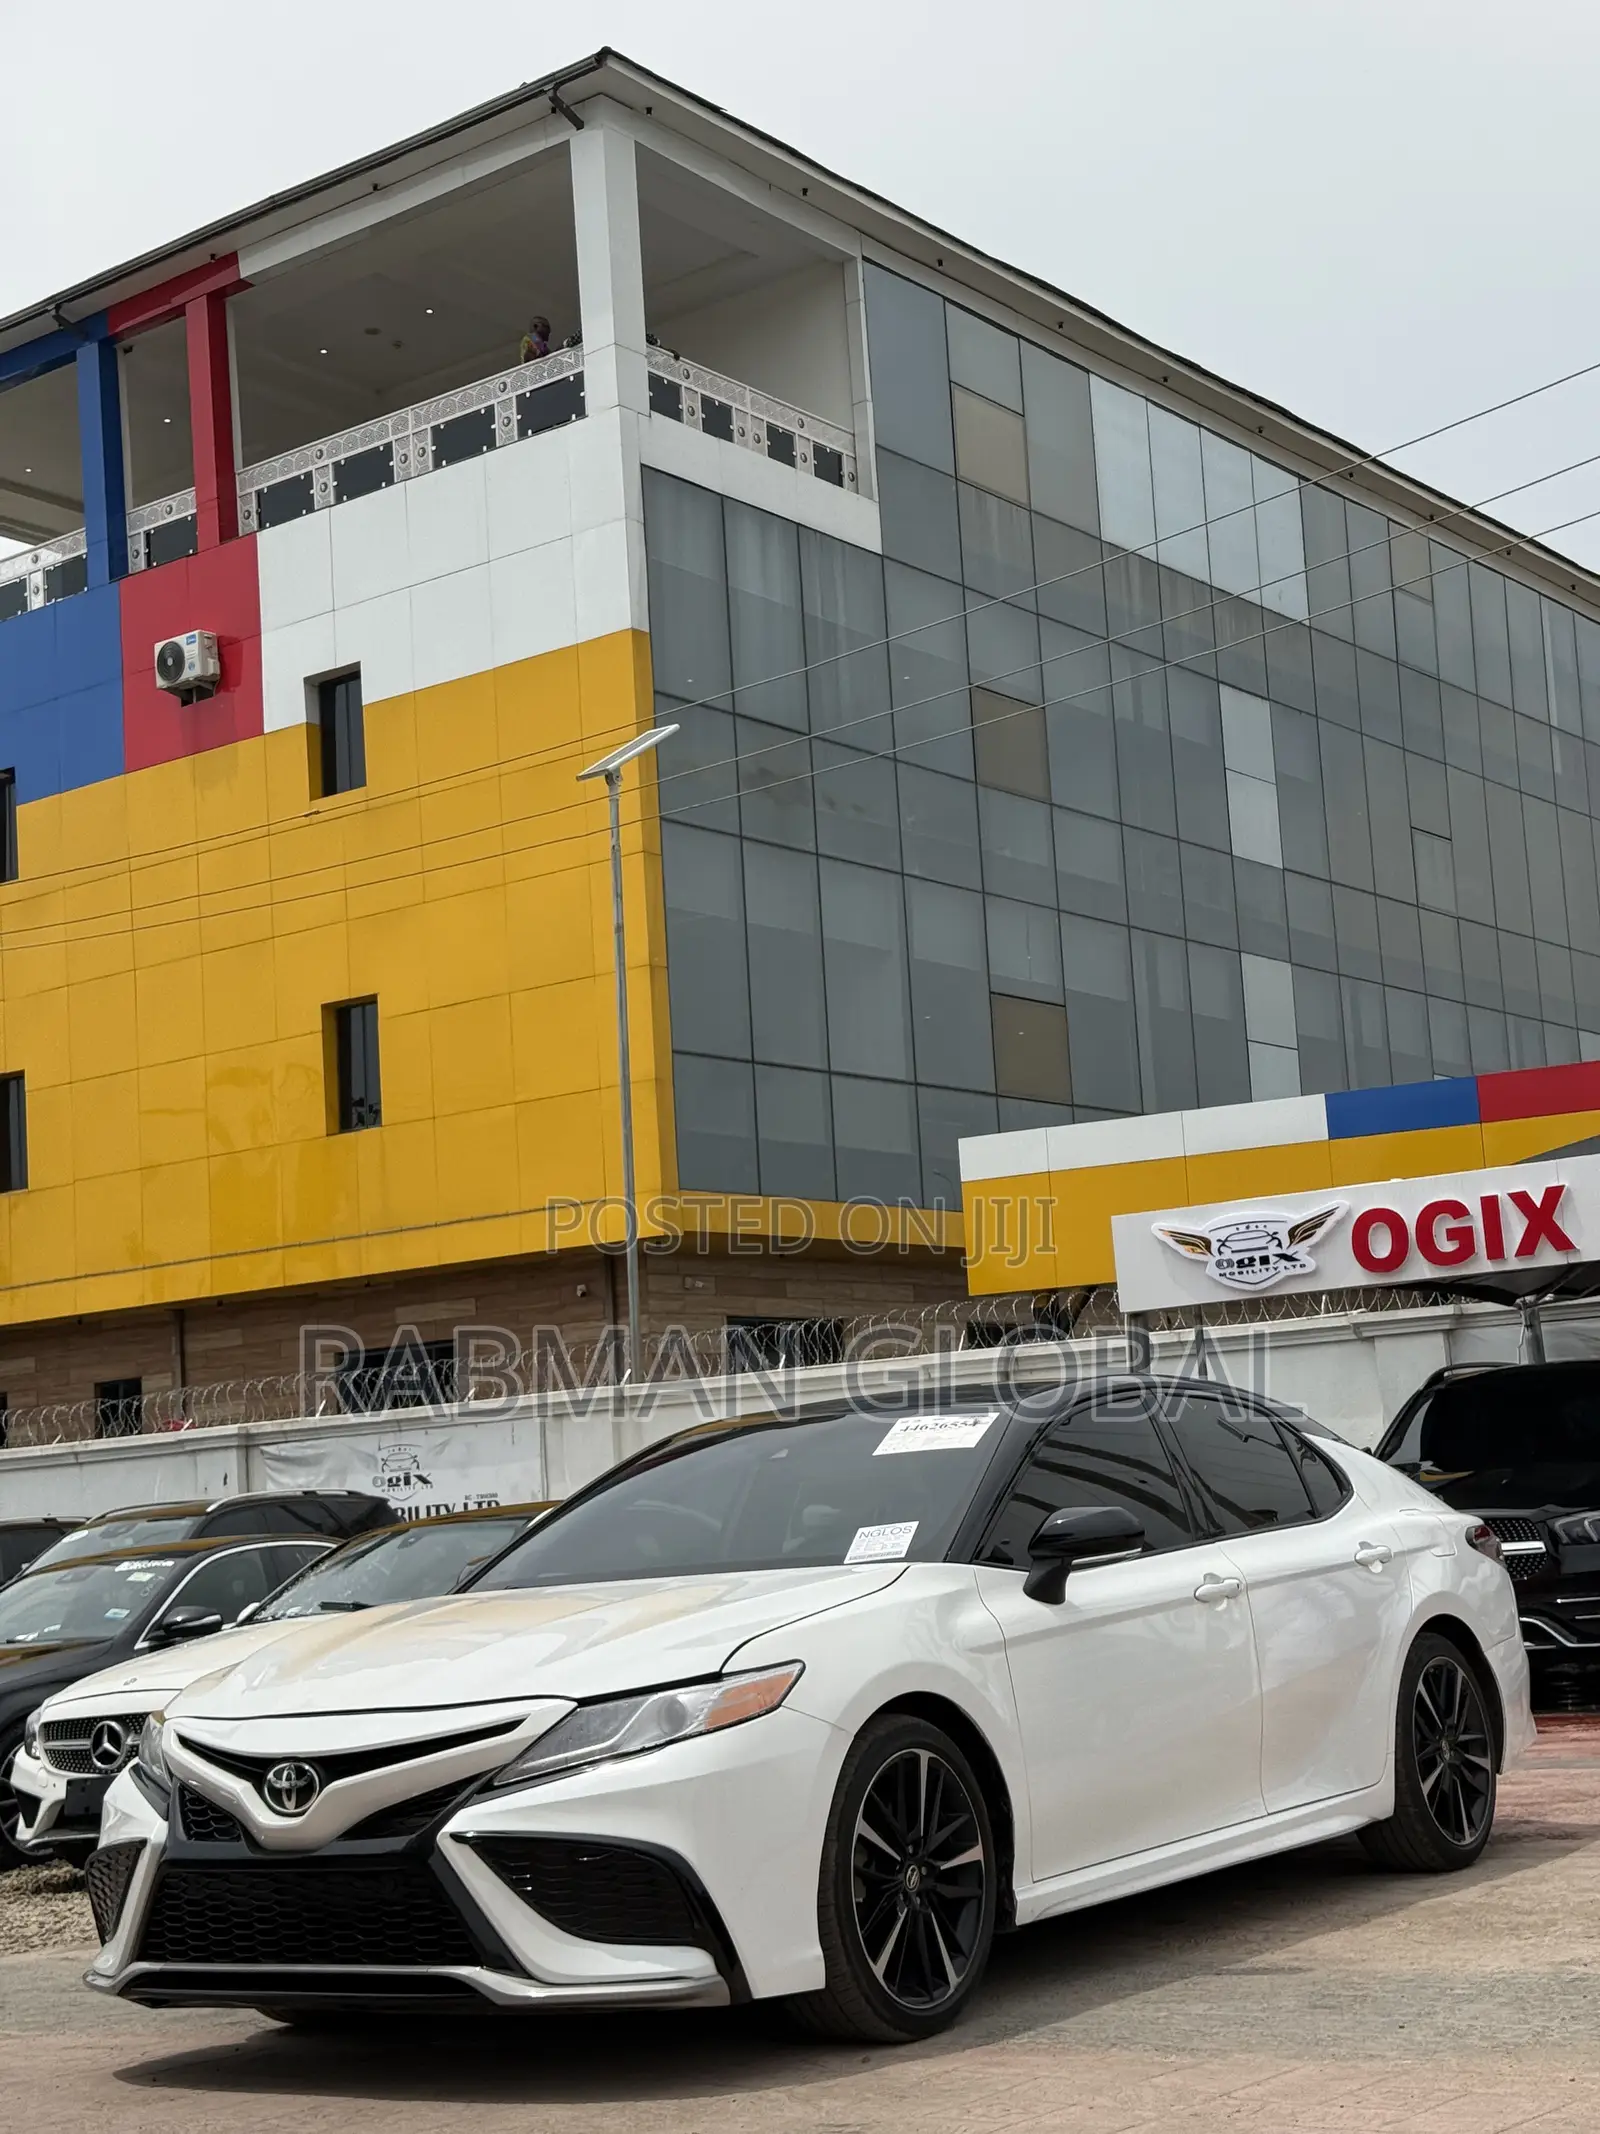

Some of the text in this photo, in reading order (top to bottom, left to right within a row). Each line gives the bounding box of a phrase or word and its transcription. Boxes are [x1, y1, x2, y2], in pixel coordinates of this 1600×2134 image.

[1351, 1184, 1579, 1273] OGIX
[1219, 1263, 1307, 1277] MOBILITY LTD
